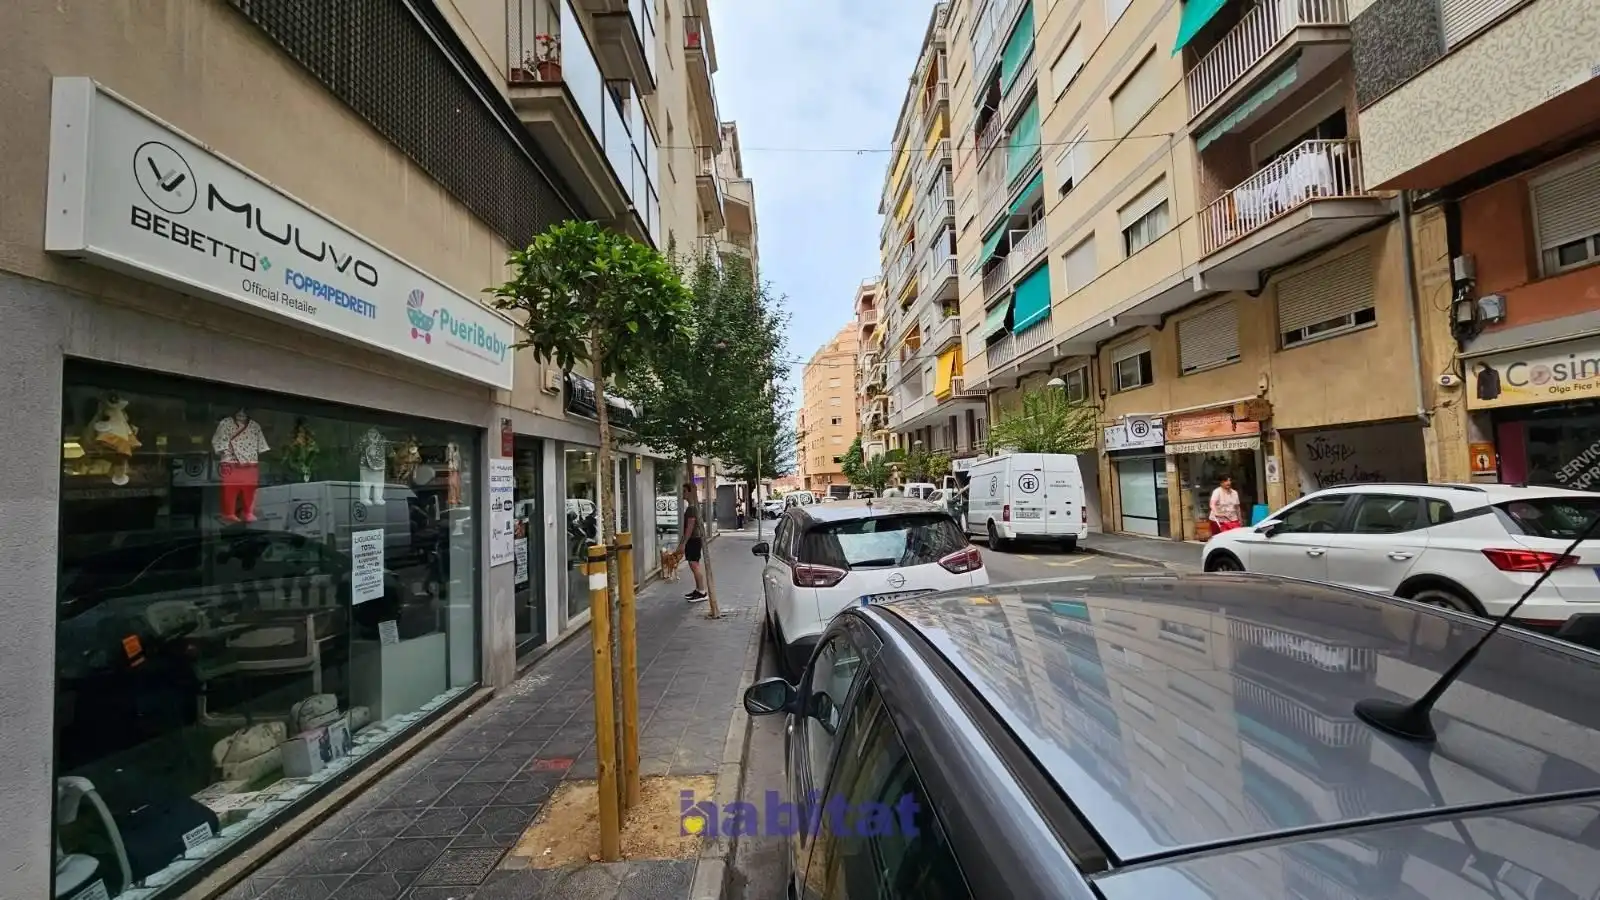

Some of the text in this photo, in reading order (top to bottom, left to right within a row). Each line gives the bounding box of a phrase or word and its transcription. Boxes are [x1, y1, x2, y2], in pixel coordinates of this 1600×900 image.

[130, 204, 256, 273] BEBETTO
[207, 183, 379, 288] MUUVO
[242, 279, 318, 316] Official Retailer
[285, 267, 377, 320] FOPPAPEDRETTI
[439, 307, 507, 362] PueriBaby
[1548, 385, 1571, 394] Olga
[1573, 383, 1592, 391] Fica
[1555, 440, 1600, 483] SERVIC
